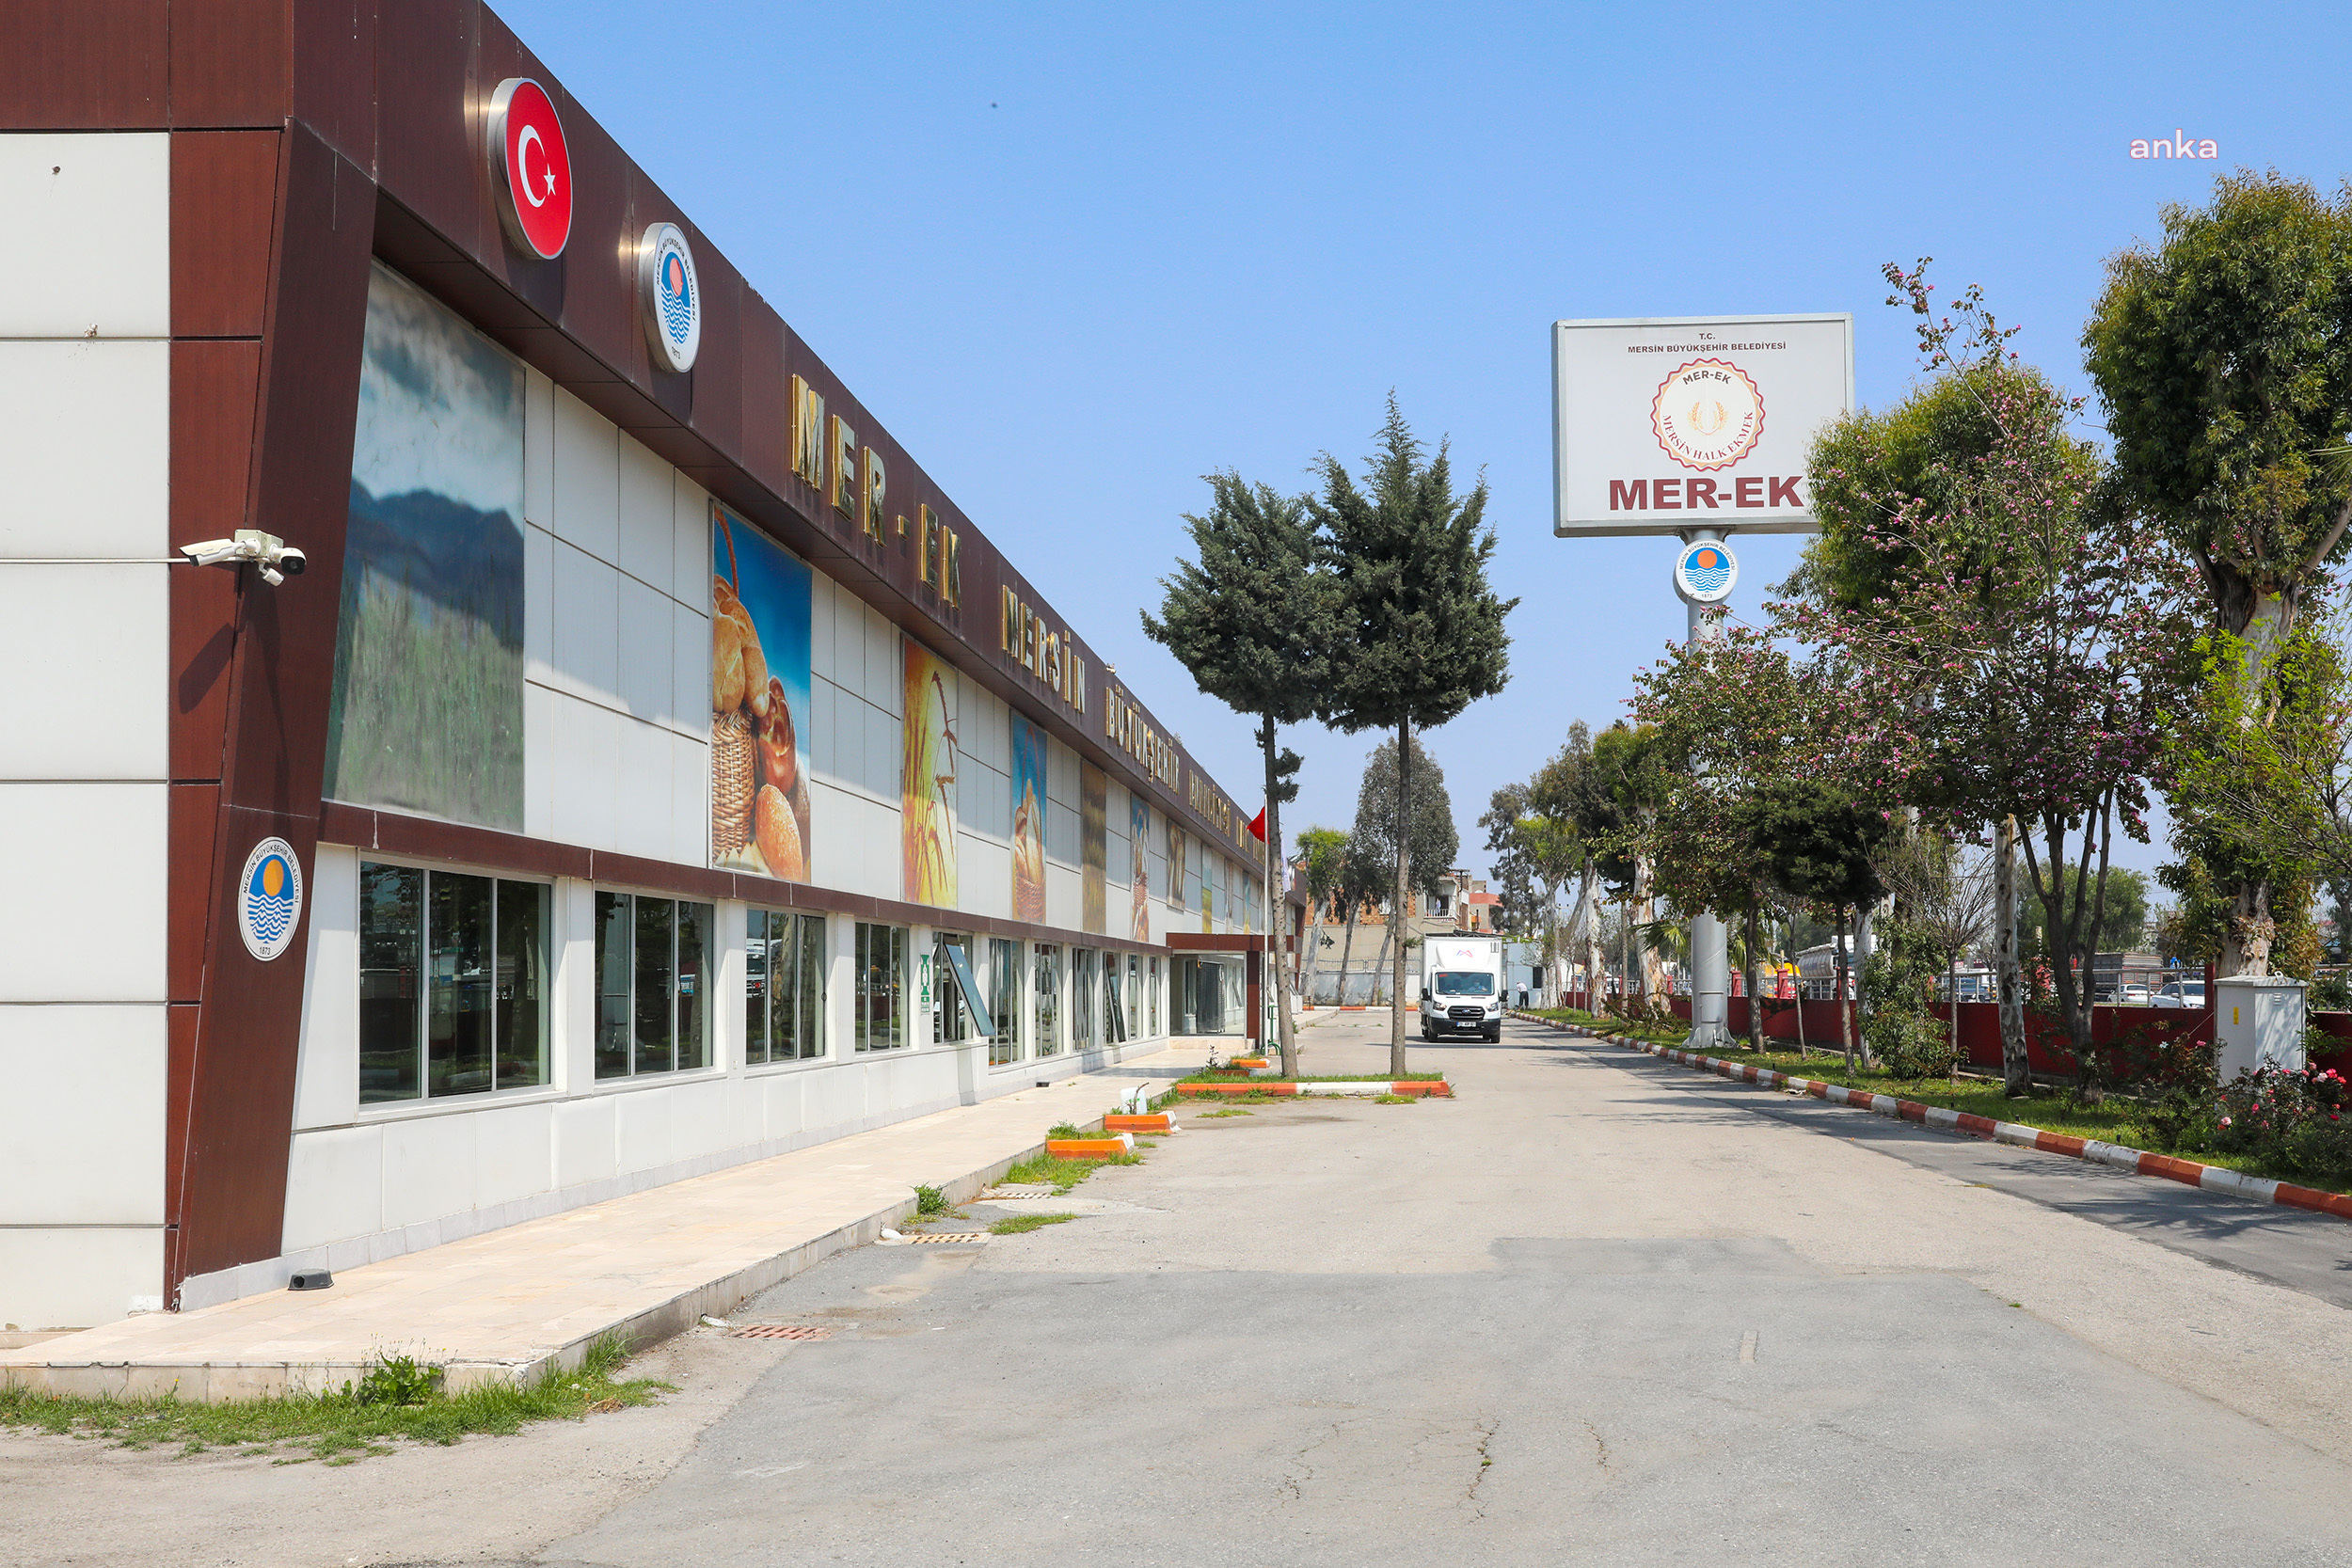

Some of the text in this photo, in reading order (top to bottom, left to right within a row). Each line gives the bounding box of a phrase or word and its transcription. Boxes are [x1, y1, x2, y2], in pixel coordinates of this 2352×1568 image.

[1698, 332, 1716, 341] T.C.
[1628, 341, 1787, 354] MERSİN BÜYÜKŞEHİR BELEDİYESİ
[1682, 370, 1732, 386] MER-EK
[1662, 411, 1754, 461] MERSİN HALK EKMEK
[1609, 475, 1804, 511] MER-EK
[1002, 584, 1086, 715] MERSİN
[1105, 684, 1180, 795] BÜYÜKŞEHİR
[260, 946, 271, 956] 1873
